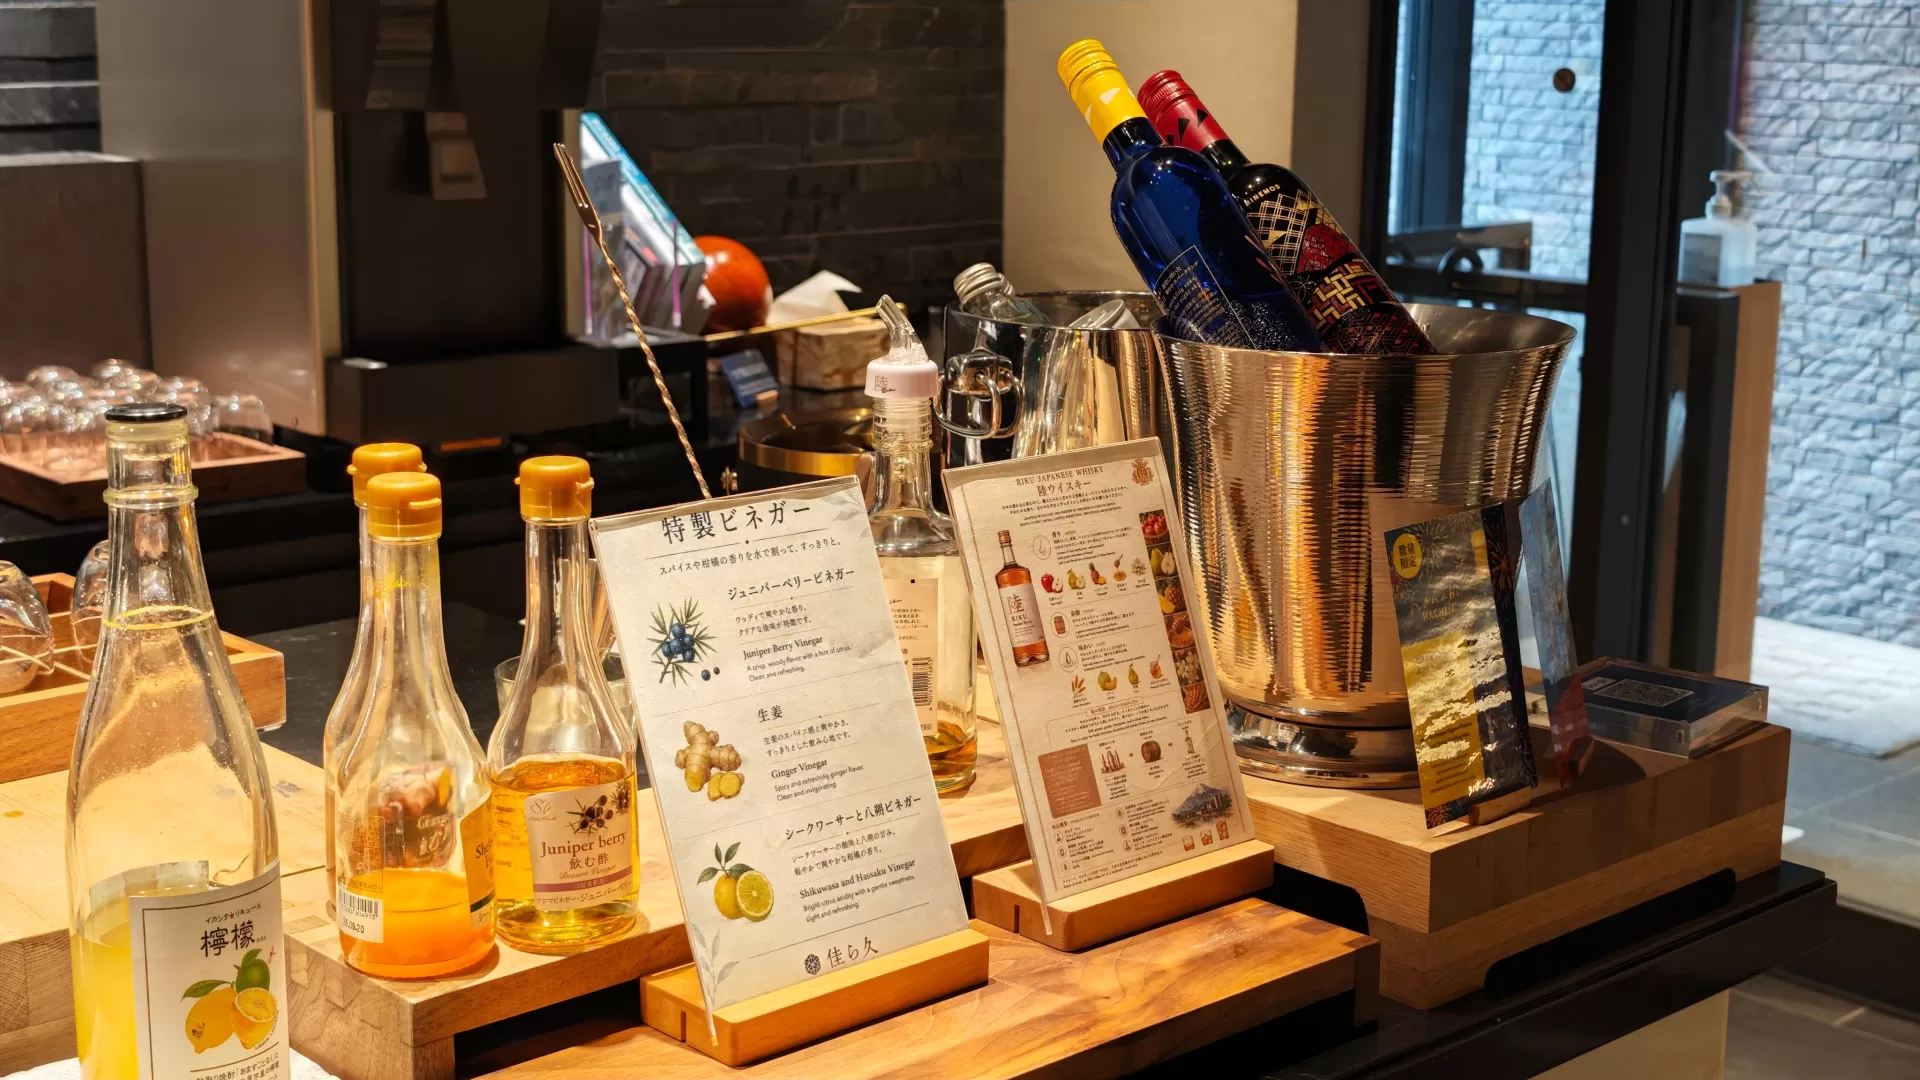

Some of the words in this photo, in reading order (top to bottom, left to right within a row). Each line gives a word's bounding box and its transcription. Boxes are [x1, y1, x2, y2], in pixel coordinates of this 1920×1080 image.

[1016, 475, 1035, 486] RIKU
[1038, 469, 1074, 483] JAPANESE
[1075, 466, 1104, 477] WHISKY
[1037, 479, 1092, 497] 陸ウイスキー
[661, 500, 810, 545] 特製ビネガー
[660, 537, 842, 576] スパイスや柑橘の香りを水で割って、すっきりと。
[727, 568, 855, 601] ジュニパーベリービネガー
[735, 604, 807, 624] ウッディで爽やかな香り。
[739, 616, 812, 637] クリアな後味が特徴です。
[743, 647, 771, 660] Juniper
[773, 642, 793, 653] Berry
[794, 636, 823, 648] Vinegar
[752, 664, 767, 672] crisp,
[768, 658, 786, 667] woody
[786, 655, 801, 664] flavor
[802, 652, 814, 660] with
[748, 673, 765, 681] Clean
[766, 671, 776, 679] and
[757, 705, 783, 722] 生姜
[763, 719, 849, 745] 生姜のスパイス感と爽やかさ。
[766, 731, 851, 757] すっきりとした飲み心地です。
[771, 767, 798, 778] Ginger
[798, 759, 828, 771] Vinegar
[774, 783, 790, 792] Spicy
[791, 780, 801, 788] and
[802, 774, 829, 785] refreshing
[830, 769, 847, 779] ginger
[776, 793, 793, 801] Clean
[794, 789, 804, 798] and
[785, 795, 922, 841] シークワーサーと八朔ビネガー
[540, 840, 595, 858] Juniper
[598, 831, 628, 849] berry
[791, 829, 896, 863] シークワーサーの酸味と八朔の甘み。
[569, 851, 610, 870] 飲む酢
[794, 845, 882, 876] 軽やかで爽やかな柑橘の香り。
[799, 883, 840, 899] Shikuwasa
[841, 874, 855, 888] and
[856, 868, 887, 883] Hassaku
[887, 859, 916, 874] Vinegar
[803, 902, 820, 912] Bright
[821, 897, 836, 906] citrus
[837, 892, 854, 903] acidity
[854, 887, 866, 896] with
[871, 882, 888, 893] gentle
[806, 913, 820, 923] Light
[821, 909, 831, 918] and
[200, 920, 256, 957] 檸檬
[826, 936, 880, 968] 佳ら久
